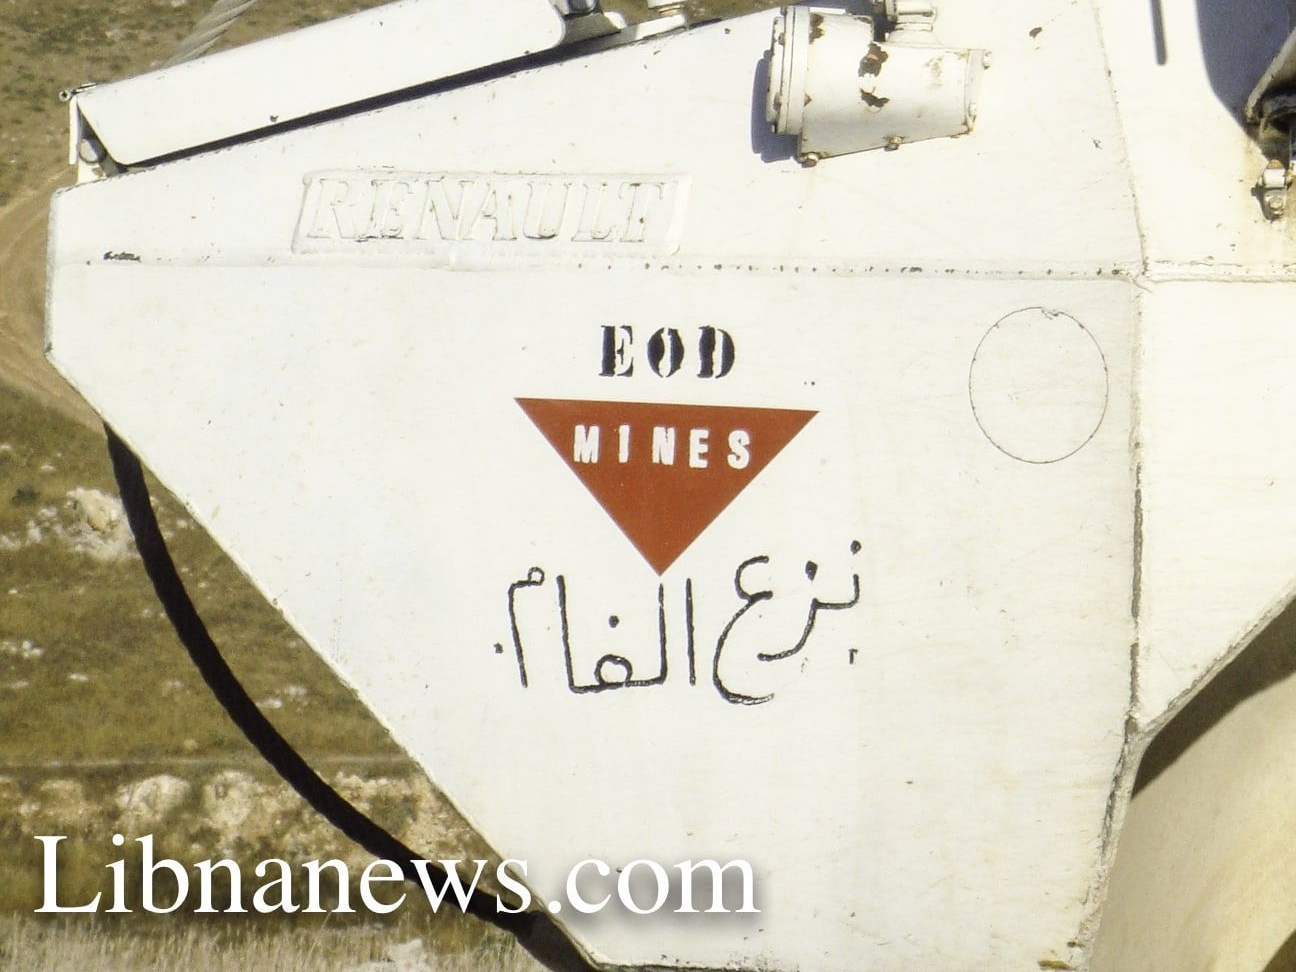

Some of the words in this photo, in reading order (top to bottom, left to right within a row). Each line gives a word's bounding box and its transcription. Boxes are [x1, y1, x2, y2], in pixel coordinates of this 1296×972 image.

[306, 177, 668, 244] RENAULT
[598, 324, 736, 379] EOD
[573, 424, 751, 470] MINES
